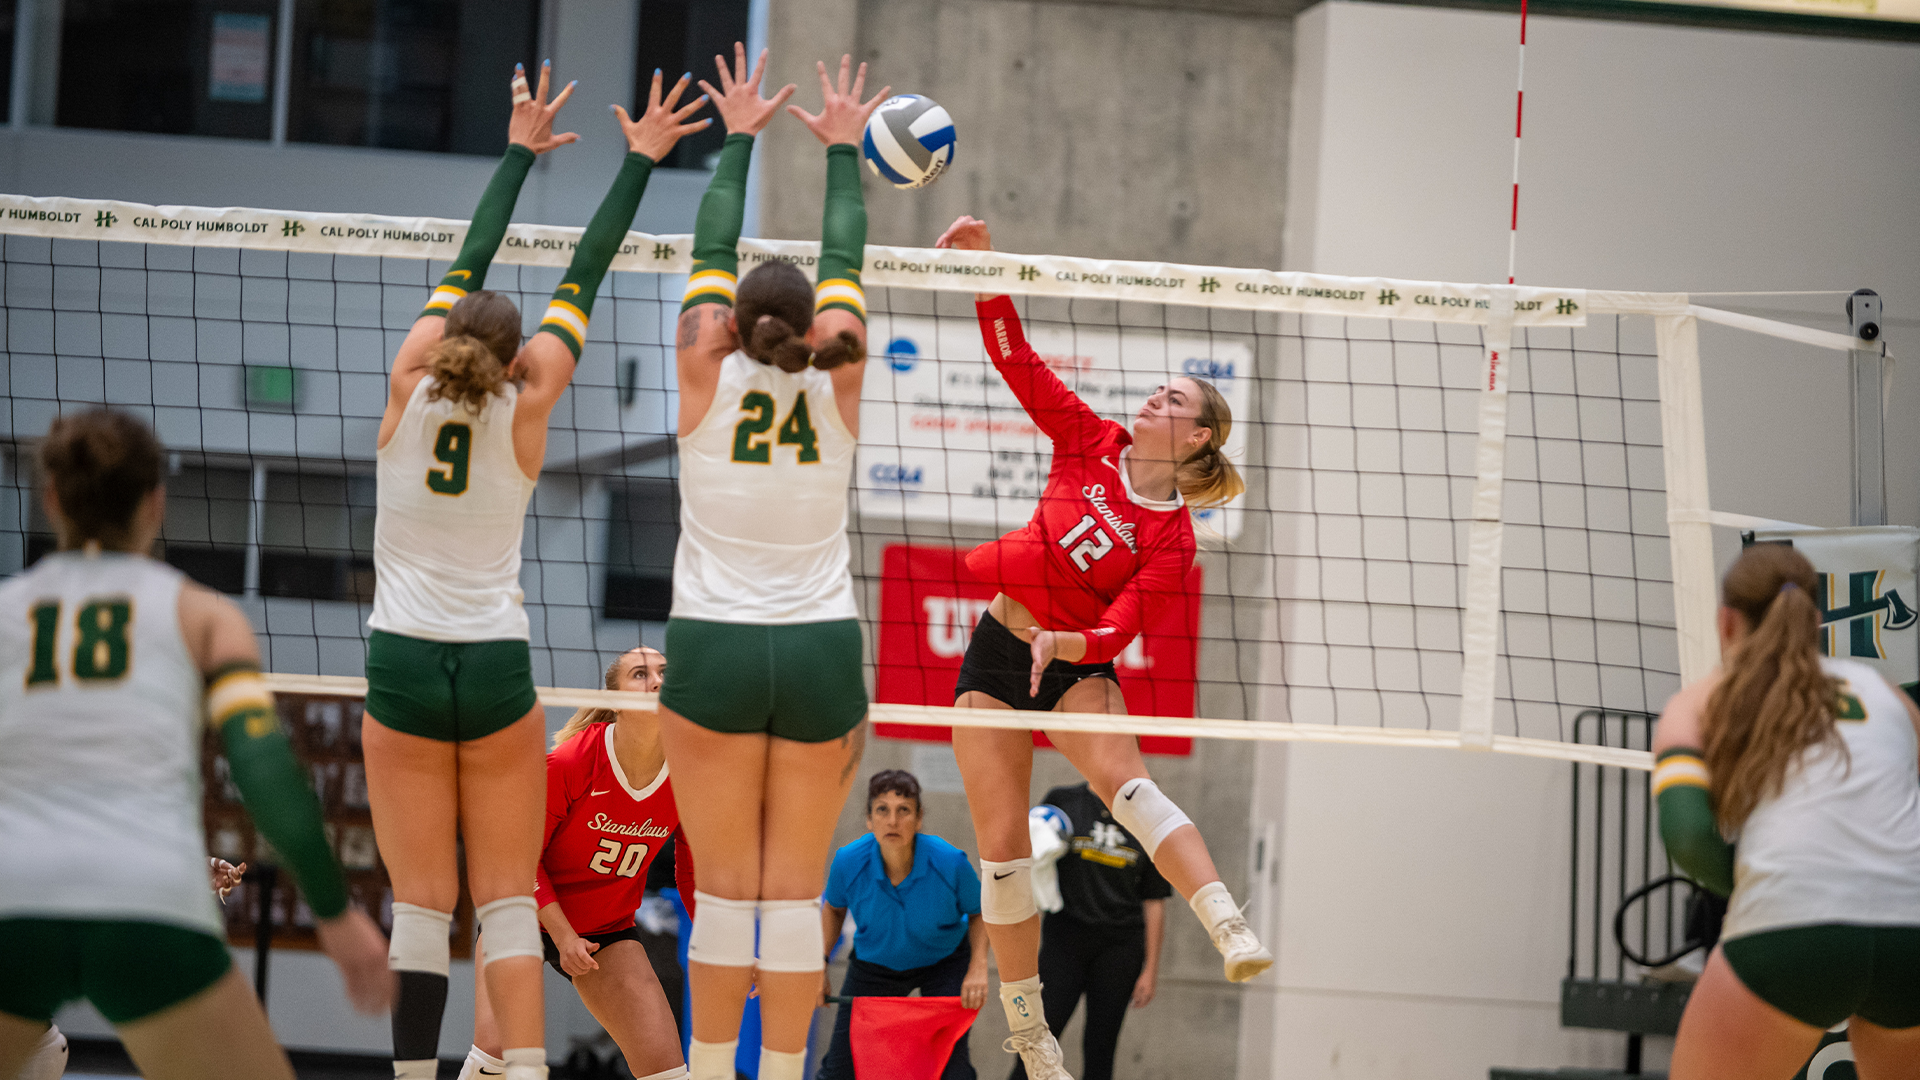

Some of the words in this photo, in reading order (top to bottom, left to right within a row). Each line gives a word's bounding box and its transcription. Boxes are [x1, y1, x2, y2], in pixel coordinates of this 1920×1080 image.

[9, 209, 81, 223] HUMBOLDT
[133, 217, 157, 228] CAL
[161, 219, 192, 230] POLY
[196, 221, 268, 233] HUMBOLDT
[321, 226, 343, 236] CAL
[348, 228, 378, 239] POLY
[383, 230, 455, 243] HUMBOLDT
[506, 237, 529, 248] CAL
[533, 239, 564, 250] POLY
[874, 260, 896, 271] CAL
[900, 262, 930, 272] POLY
[935, 264, 1005, 276] HUMBOLDT
[1056, 271, 1078, 282] CAL
[1082, 273, 1112, 284] POLY
[1116, 275, 1186, 288] HUMBOLDT
[1235, 282, 1258, 293] CAL
[1262, 284, 1292, 296] POLY
[1296, 287, 1366, 300] HUMBOLDT
[1414, 295, 1437, 306] CAL
[1441, 296, 1471, 307] POLY
[730, 389, 821, 465] 24
[426, 421, 472, 497] 9
[1082, 483, 1138, 555] Stanislaus
[1058, 514, 1114, 573] 12
[25, 594, 136, 692] 18
[587, 812, 670, 838] Stanislaus
[588, 837, 649, 878] 20
